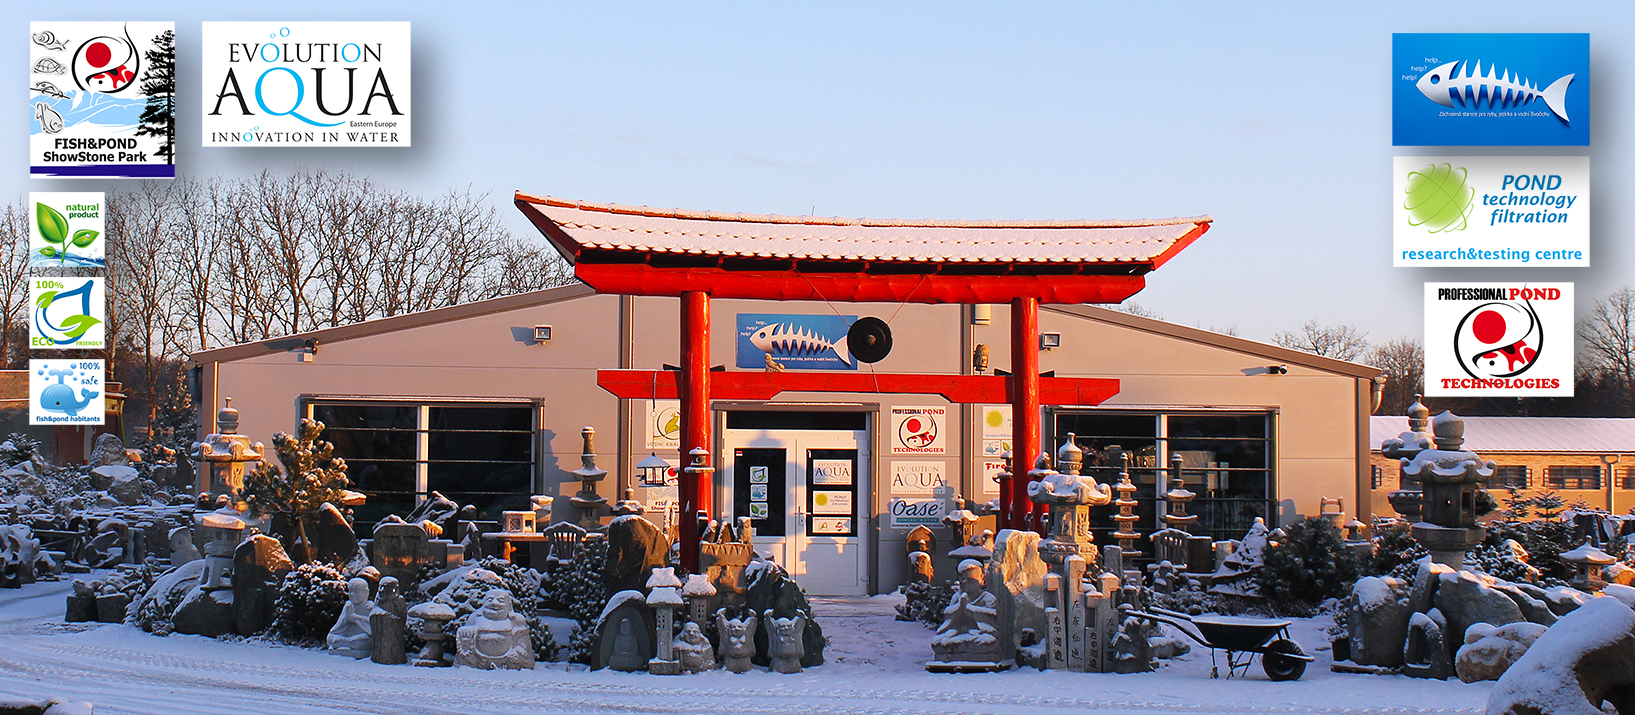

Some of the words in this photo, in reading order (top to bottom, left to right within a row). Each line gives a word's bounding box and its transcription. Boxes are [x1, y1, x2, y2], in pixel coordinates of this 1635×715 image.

[815, 467, 849, 478] AQUA
[892, 473, 944, 488] AQUA
[893, 500, 938, 516] Oase
